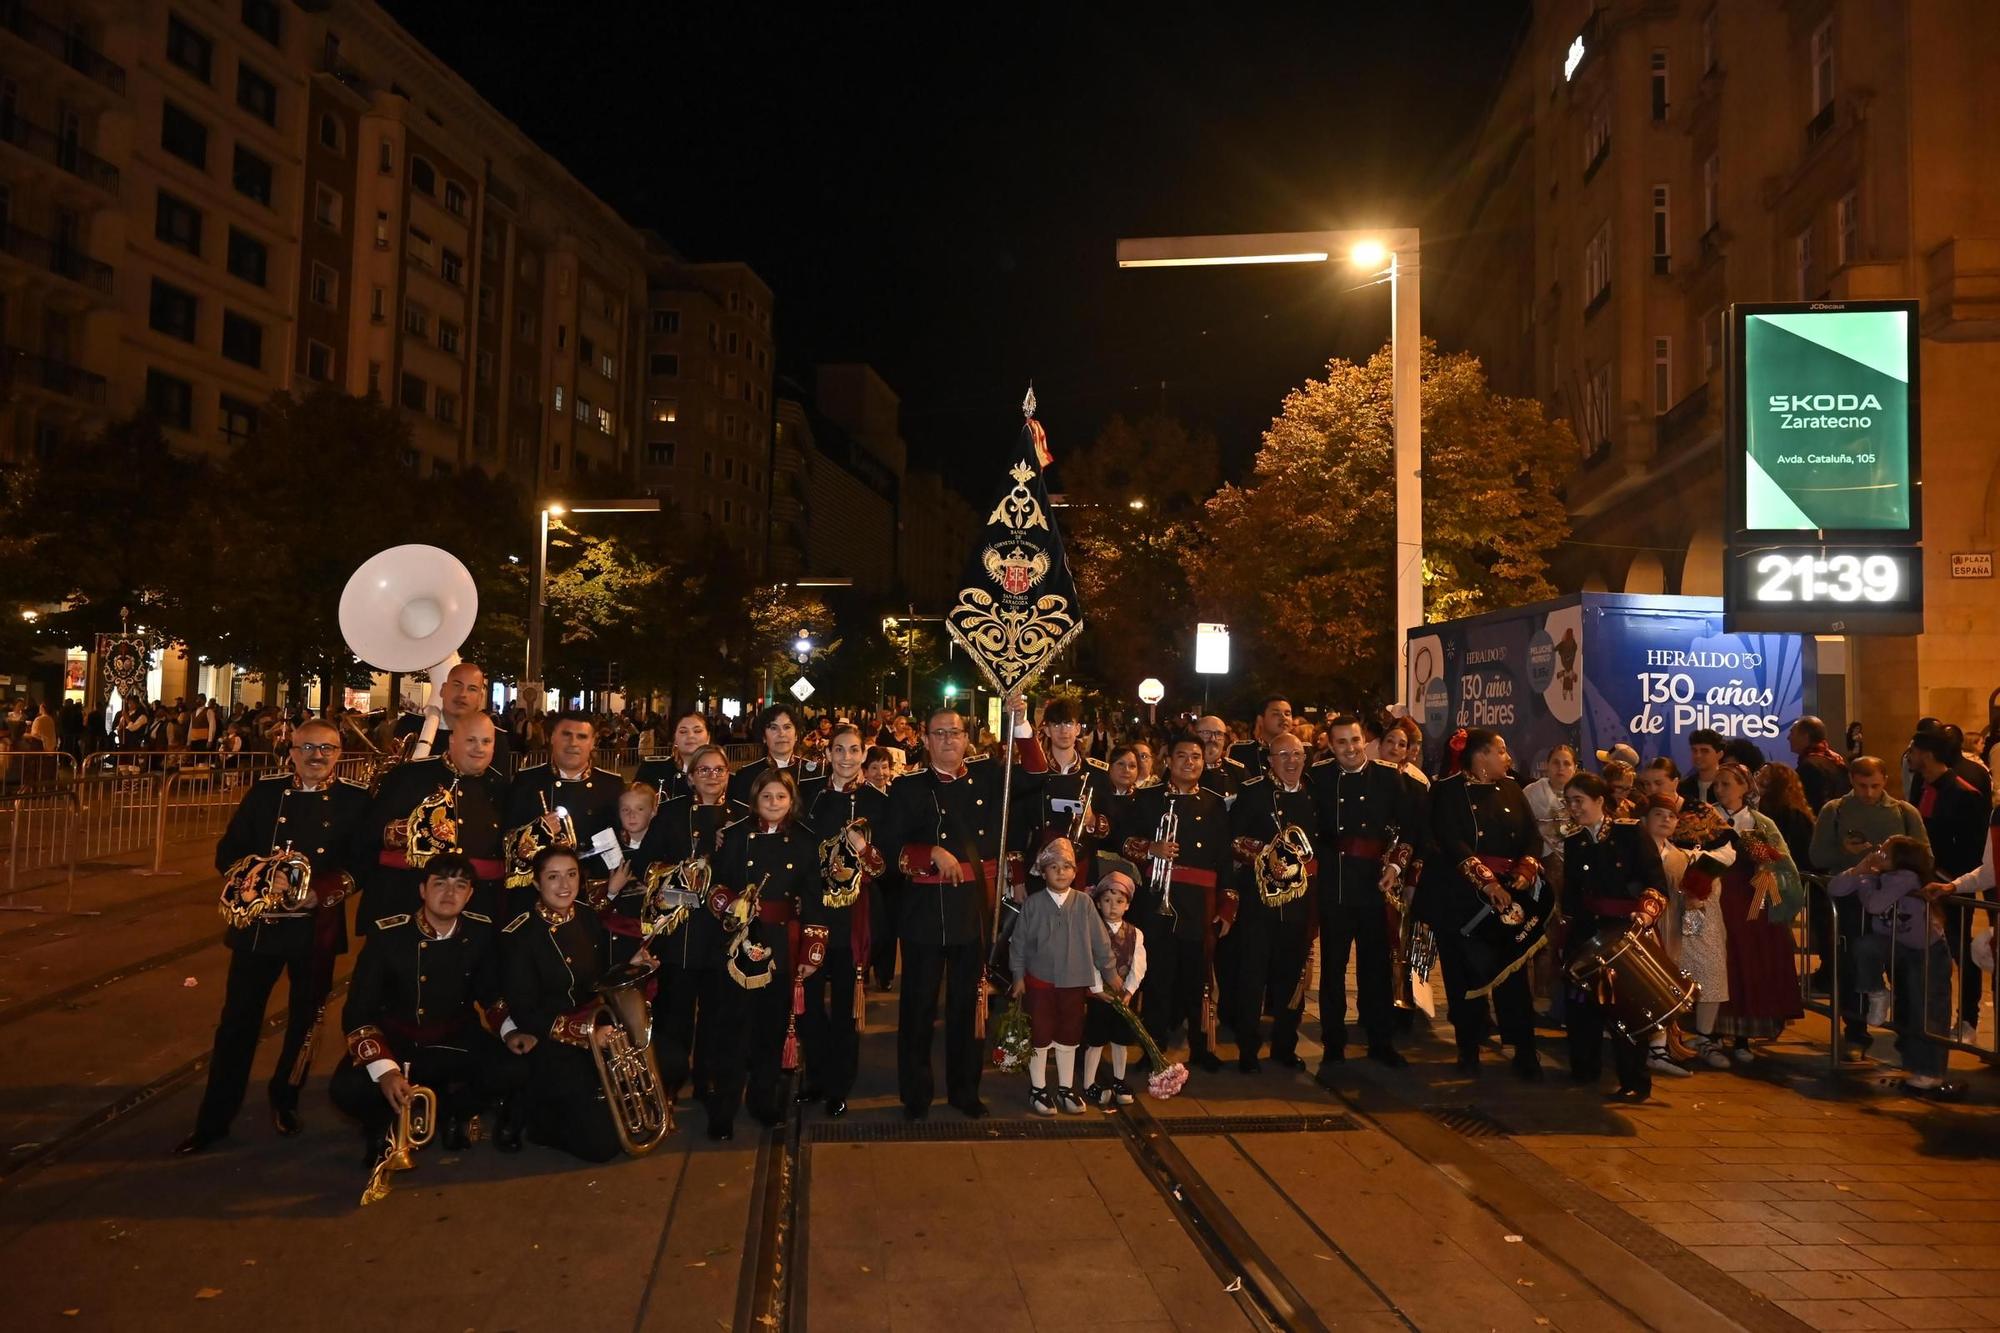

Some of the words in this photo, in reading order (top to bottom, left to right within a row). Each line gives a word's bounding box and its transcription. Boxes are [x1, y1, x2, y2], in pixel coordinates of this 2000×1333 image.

[1780, 413, 1872, 429] Zaratecno
[1777, 454, 1806, 464] Avda.
[1807, 453, 1855, 466] Cataluña,
[1856, 454, 1876, 464] 105
[1757, 555, 1899, 602] 21:39
[1466, 648, 1499, 665] HERALDO
[1647, 649, 1740, 669] HERALDO
[1460, 673, 1482, 701] 130
[1485, 675, 1513, 698] años
[1636, 672, 1695, 705] 130
[1705, 679, 1774, 708] años
[1456, 701, 1470, 728] de
[1473, 697, 1515, 726] Pilares
[1630, 704, 1665, 735] de
[1674, 704, 1780, 739] Pilares
